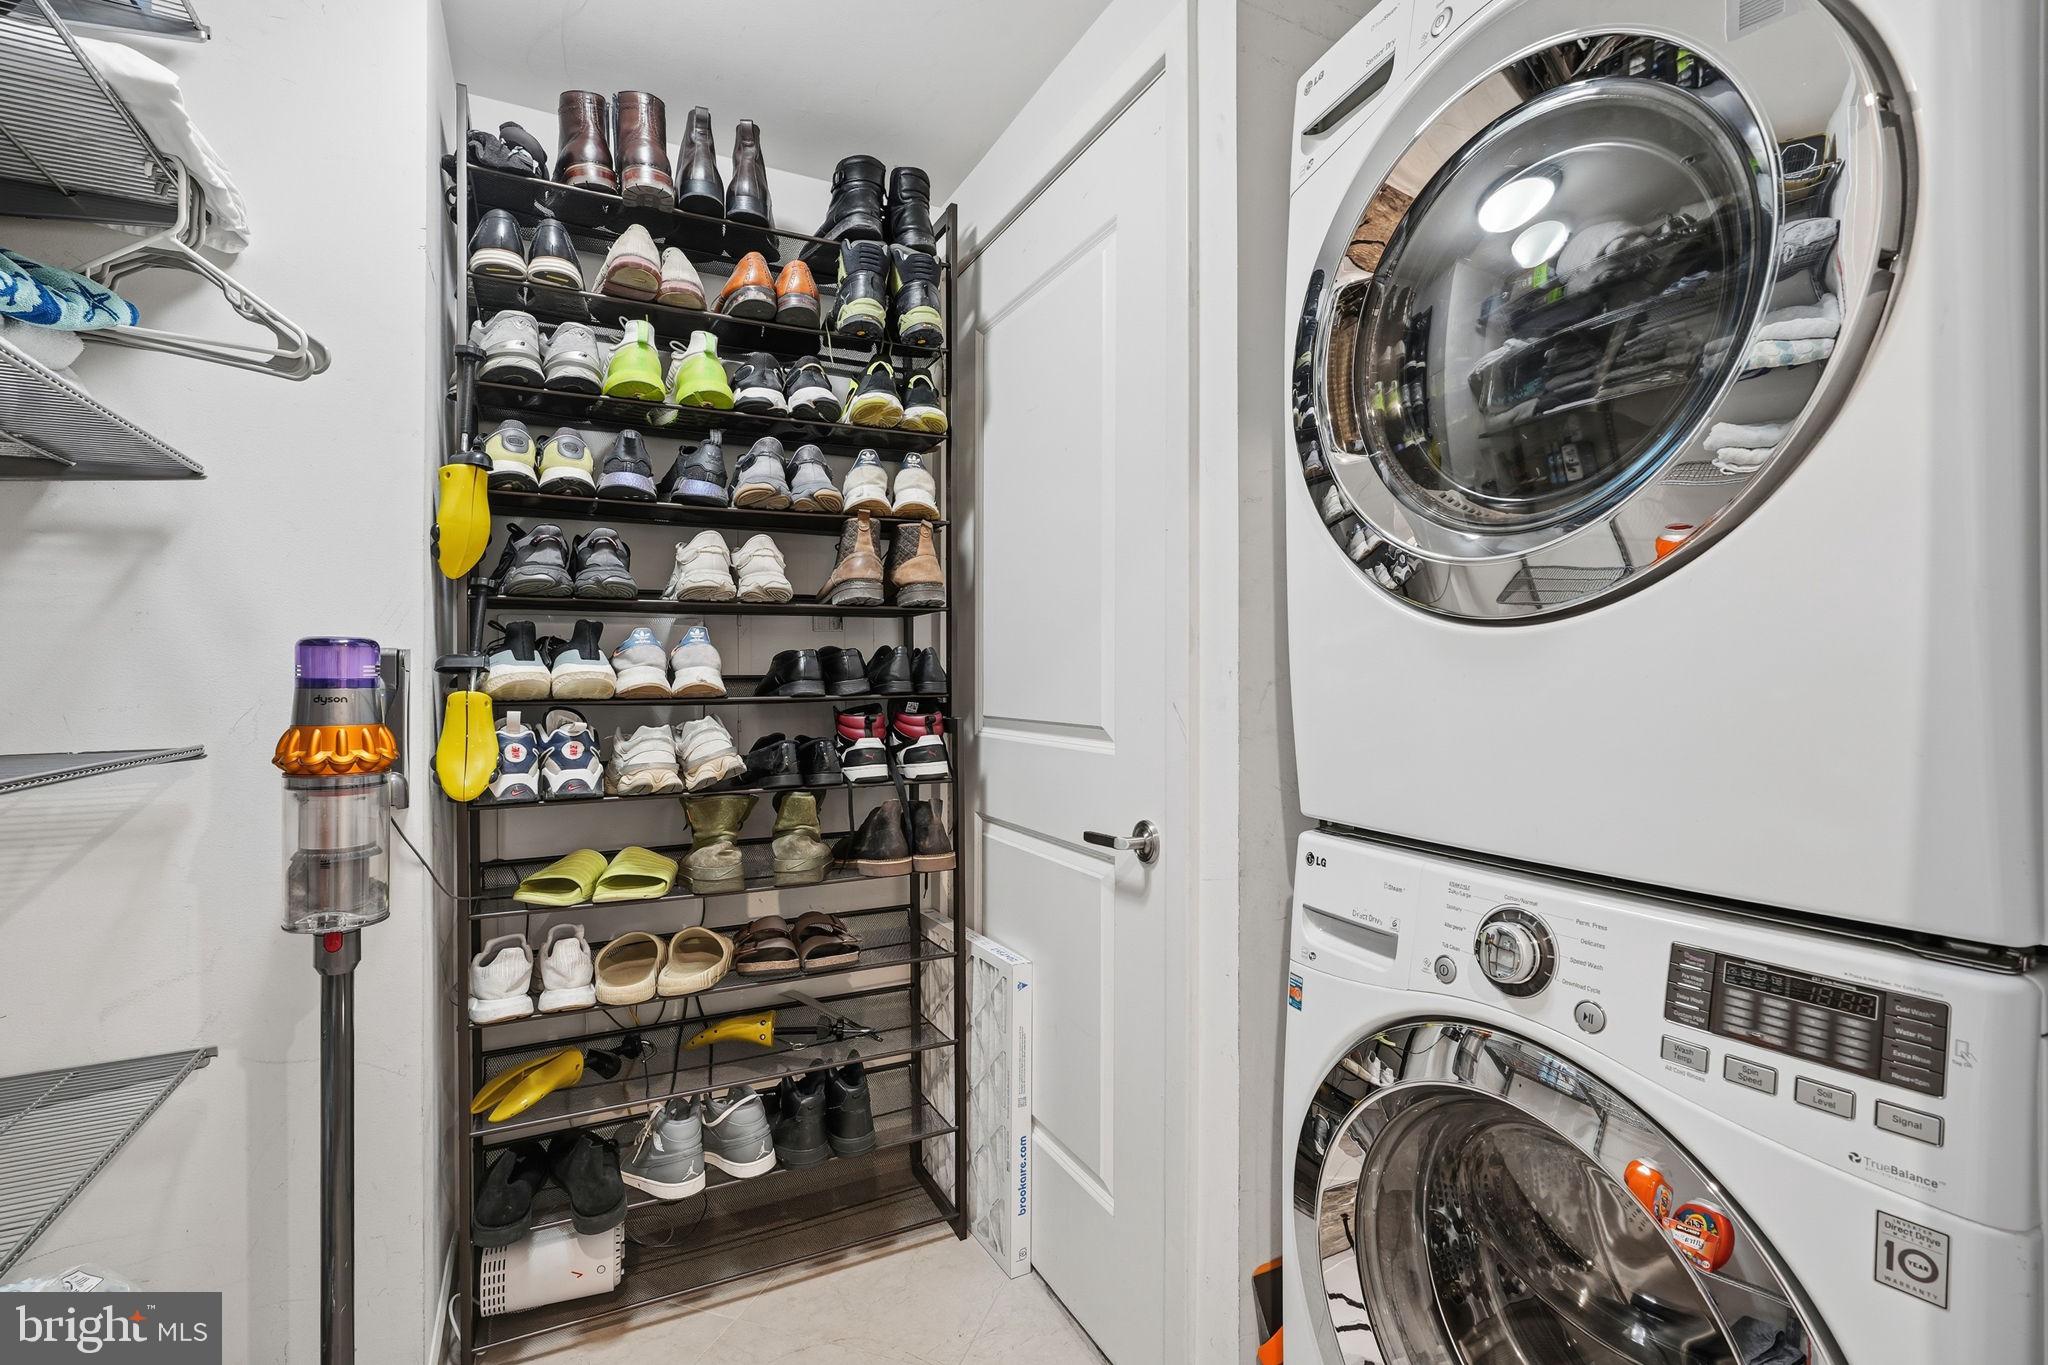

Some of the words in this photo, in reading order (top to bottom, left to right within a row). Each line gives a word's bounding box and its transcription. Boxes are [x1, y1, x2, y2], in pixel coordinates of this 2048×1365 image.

[313, 695, 348, 705] dyson
[1592, 922, 1608, 931] Press
[1580, 938, 1606, 950] Delicates
[1570, 957, 1586, 967] Speed
[1587, 961, 1604, 971] Wash
[1562, 978, 1586, 991] Download
[1587, 985, 1601, 995] Cycle
[1673, 1010, 1692, 1020] Custom
[1895, 1005, 1911, 1014] Cold
[1894, 1026, 1916, 1037] Water
[1917, 1032, 1932, 1042] Plus
[1674, 1044, 1695, 1056] Wash
[1892, 1049, 1912, 1060] Extra
[1673, 1052, 1694, 1065] Temp.
[1742, 1065, 1759, 1077] Spin
[1737, 1072, 1762, 1087] Speed
[1816, 1088, 1833, 1099] Soil
[1812, 1095, 1836, 1110] Level
[1891, 1114, 1923, 1131] Signal
[1018, 1135, 1027, 1216] brookaire.com
[1884, 1220, 1913, 1237] Direct
[1915, 1231, 1942, 1247] Drive
[1884, 1239, 1940, 1284] 10
[1907, 1259, 1929, 1273] YEAR
[1883, 1274, 1938, 1301] WARRANTY
